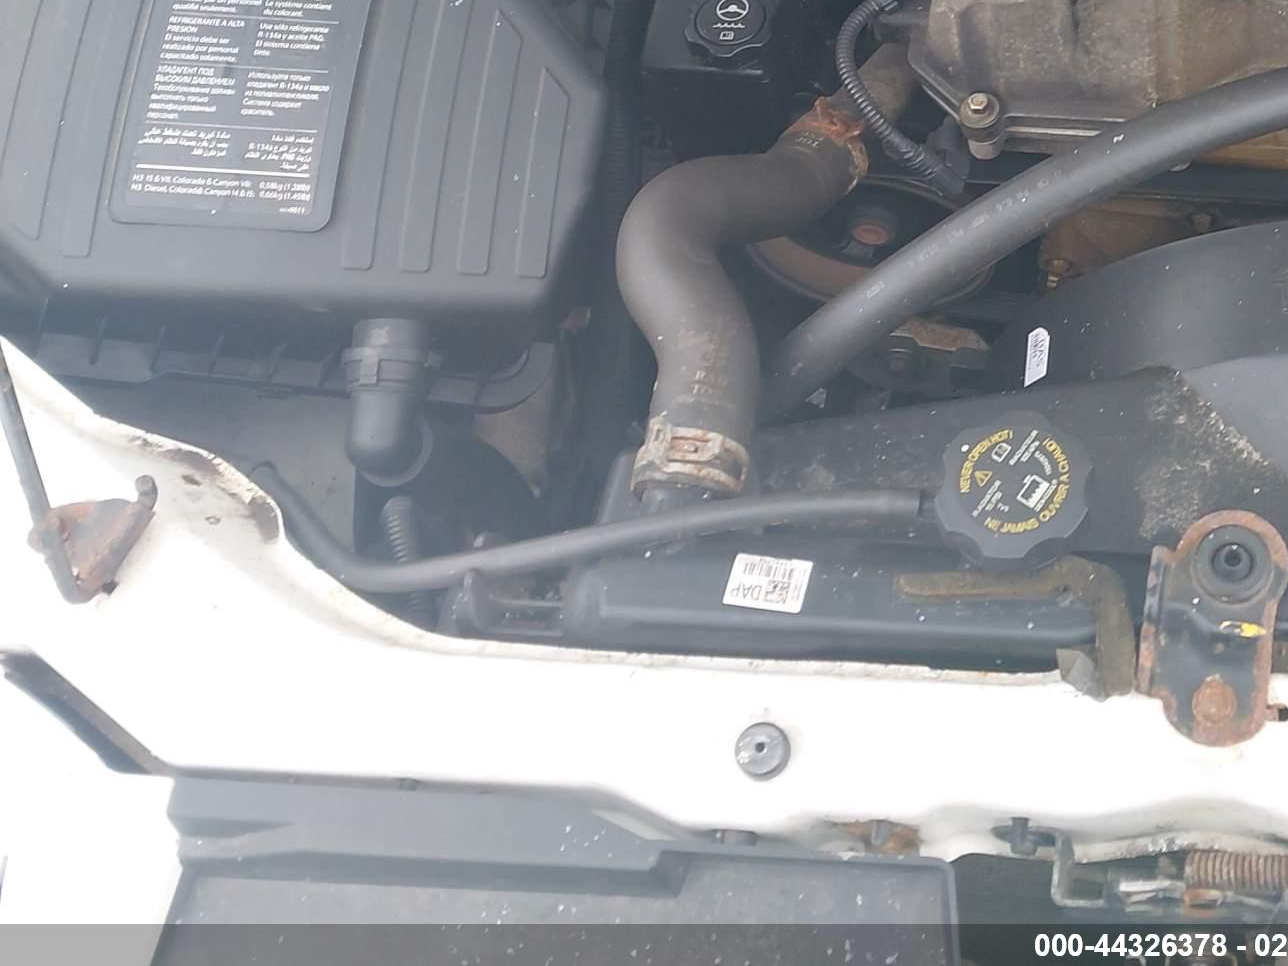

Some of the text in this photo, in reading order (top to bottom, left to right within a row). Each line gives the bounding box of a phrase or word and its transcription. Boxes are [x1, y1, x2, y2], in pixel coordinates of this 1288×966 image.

[169, 16, 246, 28] REFRIGERANTE A ALTA
[132, 174, 144, 182] H3
[153, 175, 161, 183] &
[172, 176, 206, 185] Colorado
[212, 179, 240, 188] Canyon
[131, 183, 143, 191] H3
[203, 188, 232, 197] Canyon
[960, 429, 1014, 493] NEVER OPEN HOT!
[1042, 437, 1070, 473] CHAUD!
[1039, 483, 1070, 522] OUVRIR
[984, 516, 1001, 531] NE
[1000, 517, 1040, 533] JAMAIS
[731, 582, 762, 601] DAP
